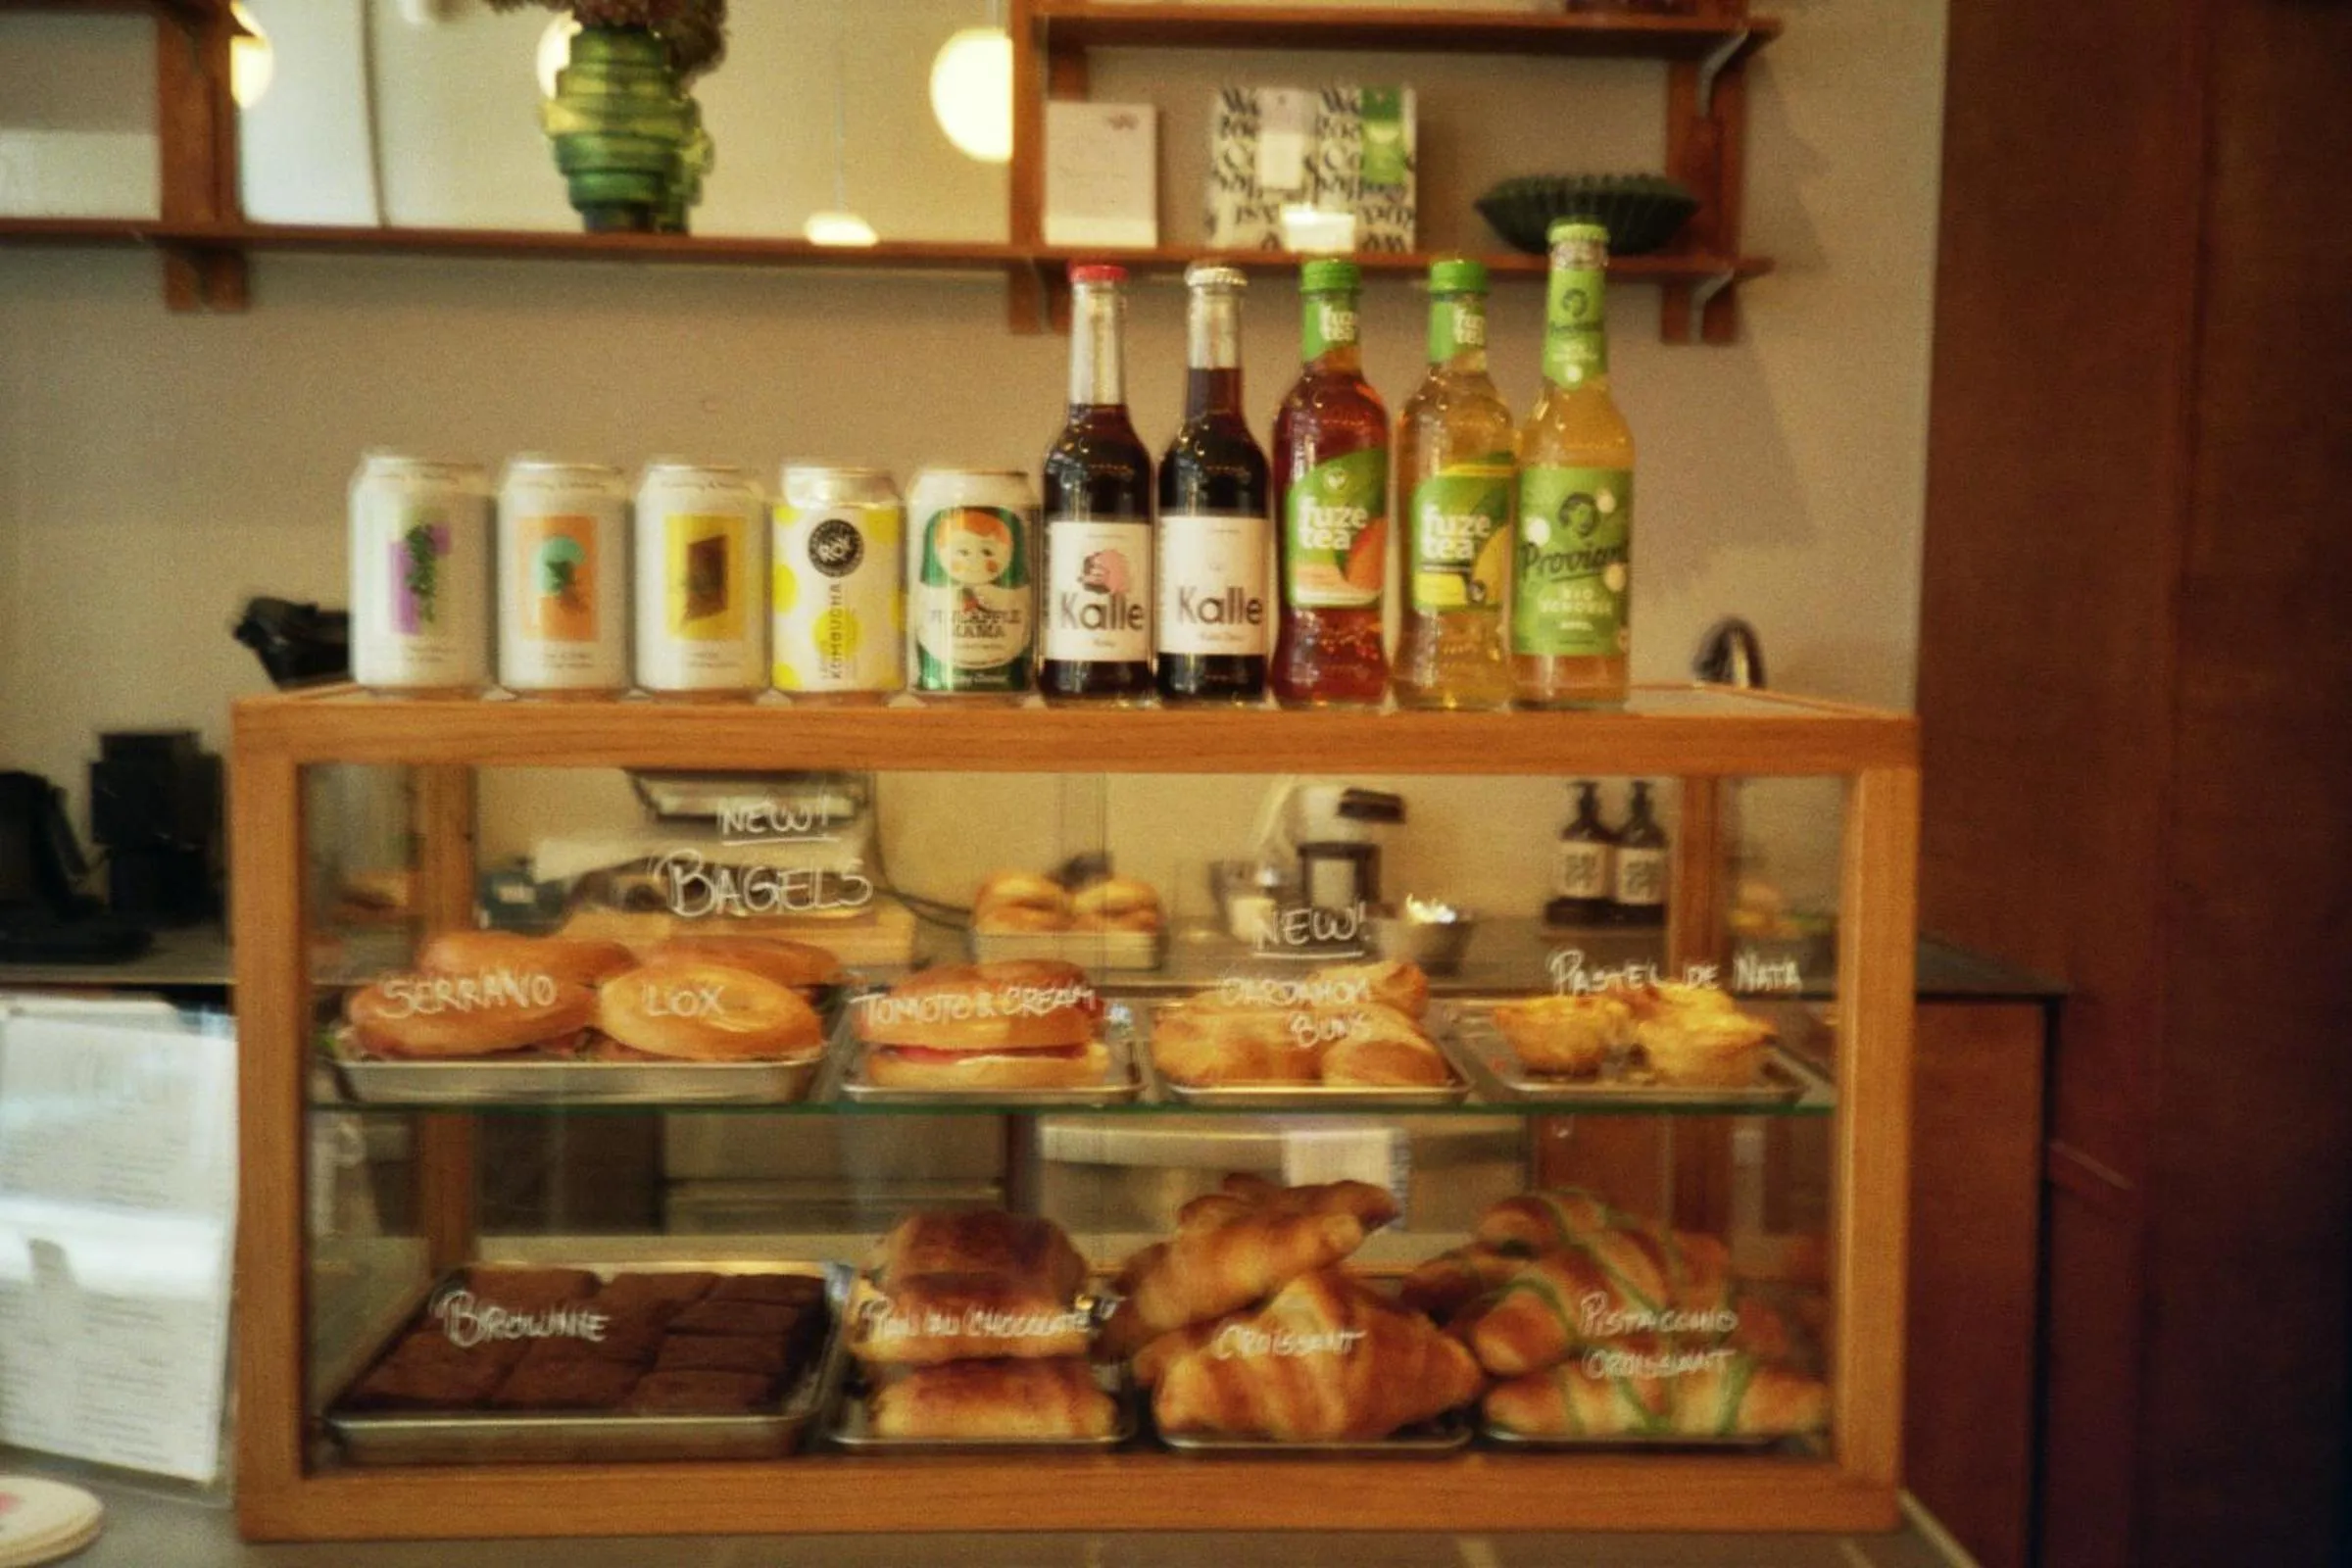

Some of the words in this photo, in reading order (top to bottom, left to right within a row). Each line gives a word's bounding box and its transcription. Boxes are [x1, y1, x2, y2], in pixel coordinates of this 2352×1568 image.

[1298, 494, 1368, 529] fuze
[1423, 503, 1492, 537] fuze
[1298, 526, 1351, 551] tea
[1058, 592, 1145, 630] Kalle
[1176, 586, 1263, 625] Kalle
[651, 848, 873, 917] BAGELS
[1252, 898, 1371, 950] NEW!
[375, 969, 557, 1019] SERRANO
[643, 983, 727, 1017] LOX
